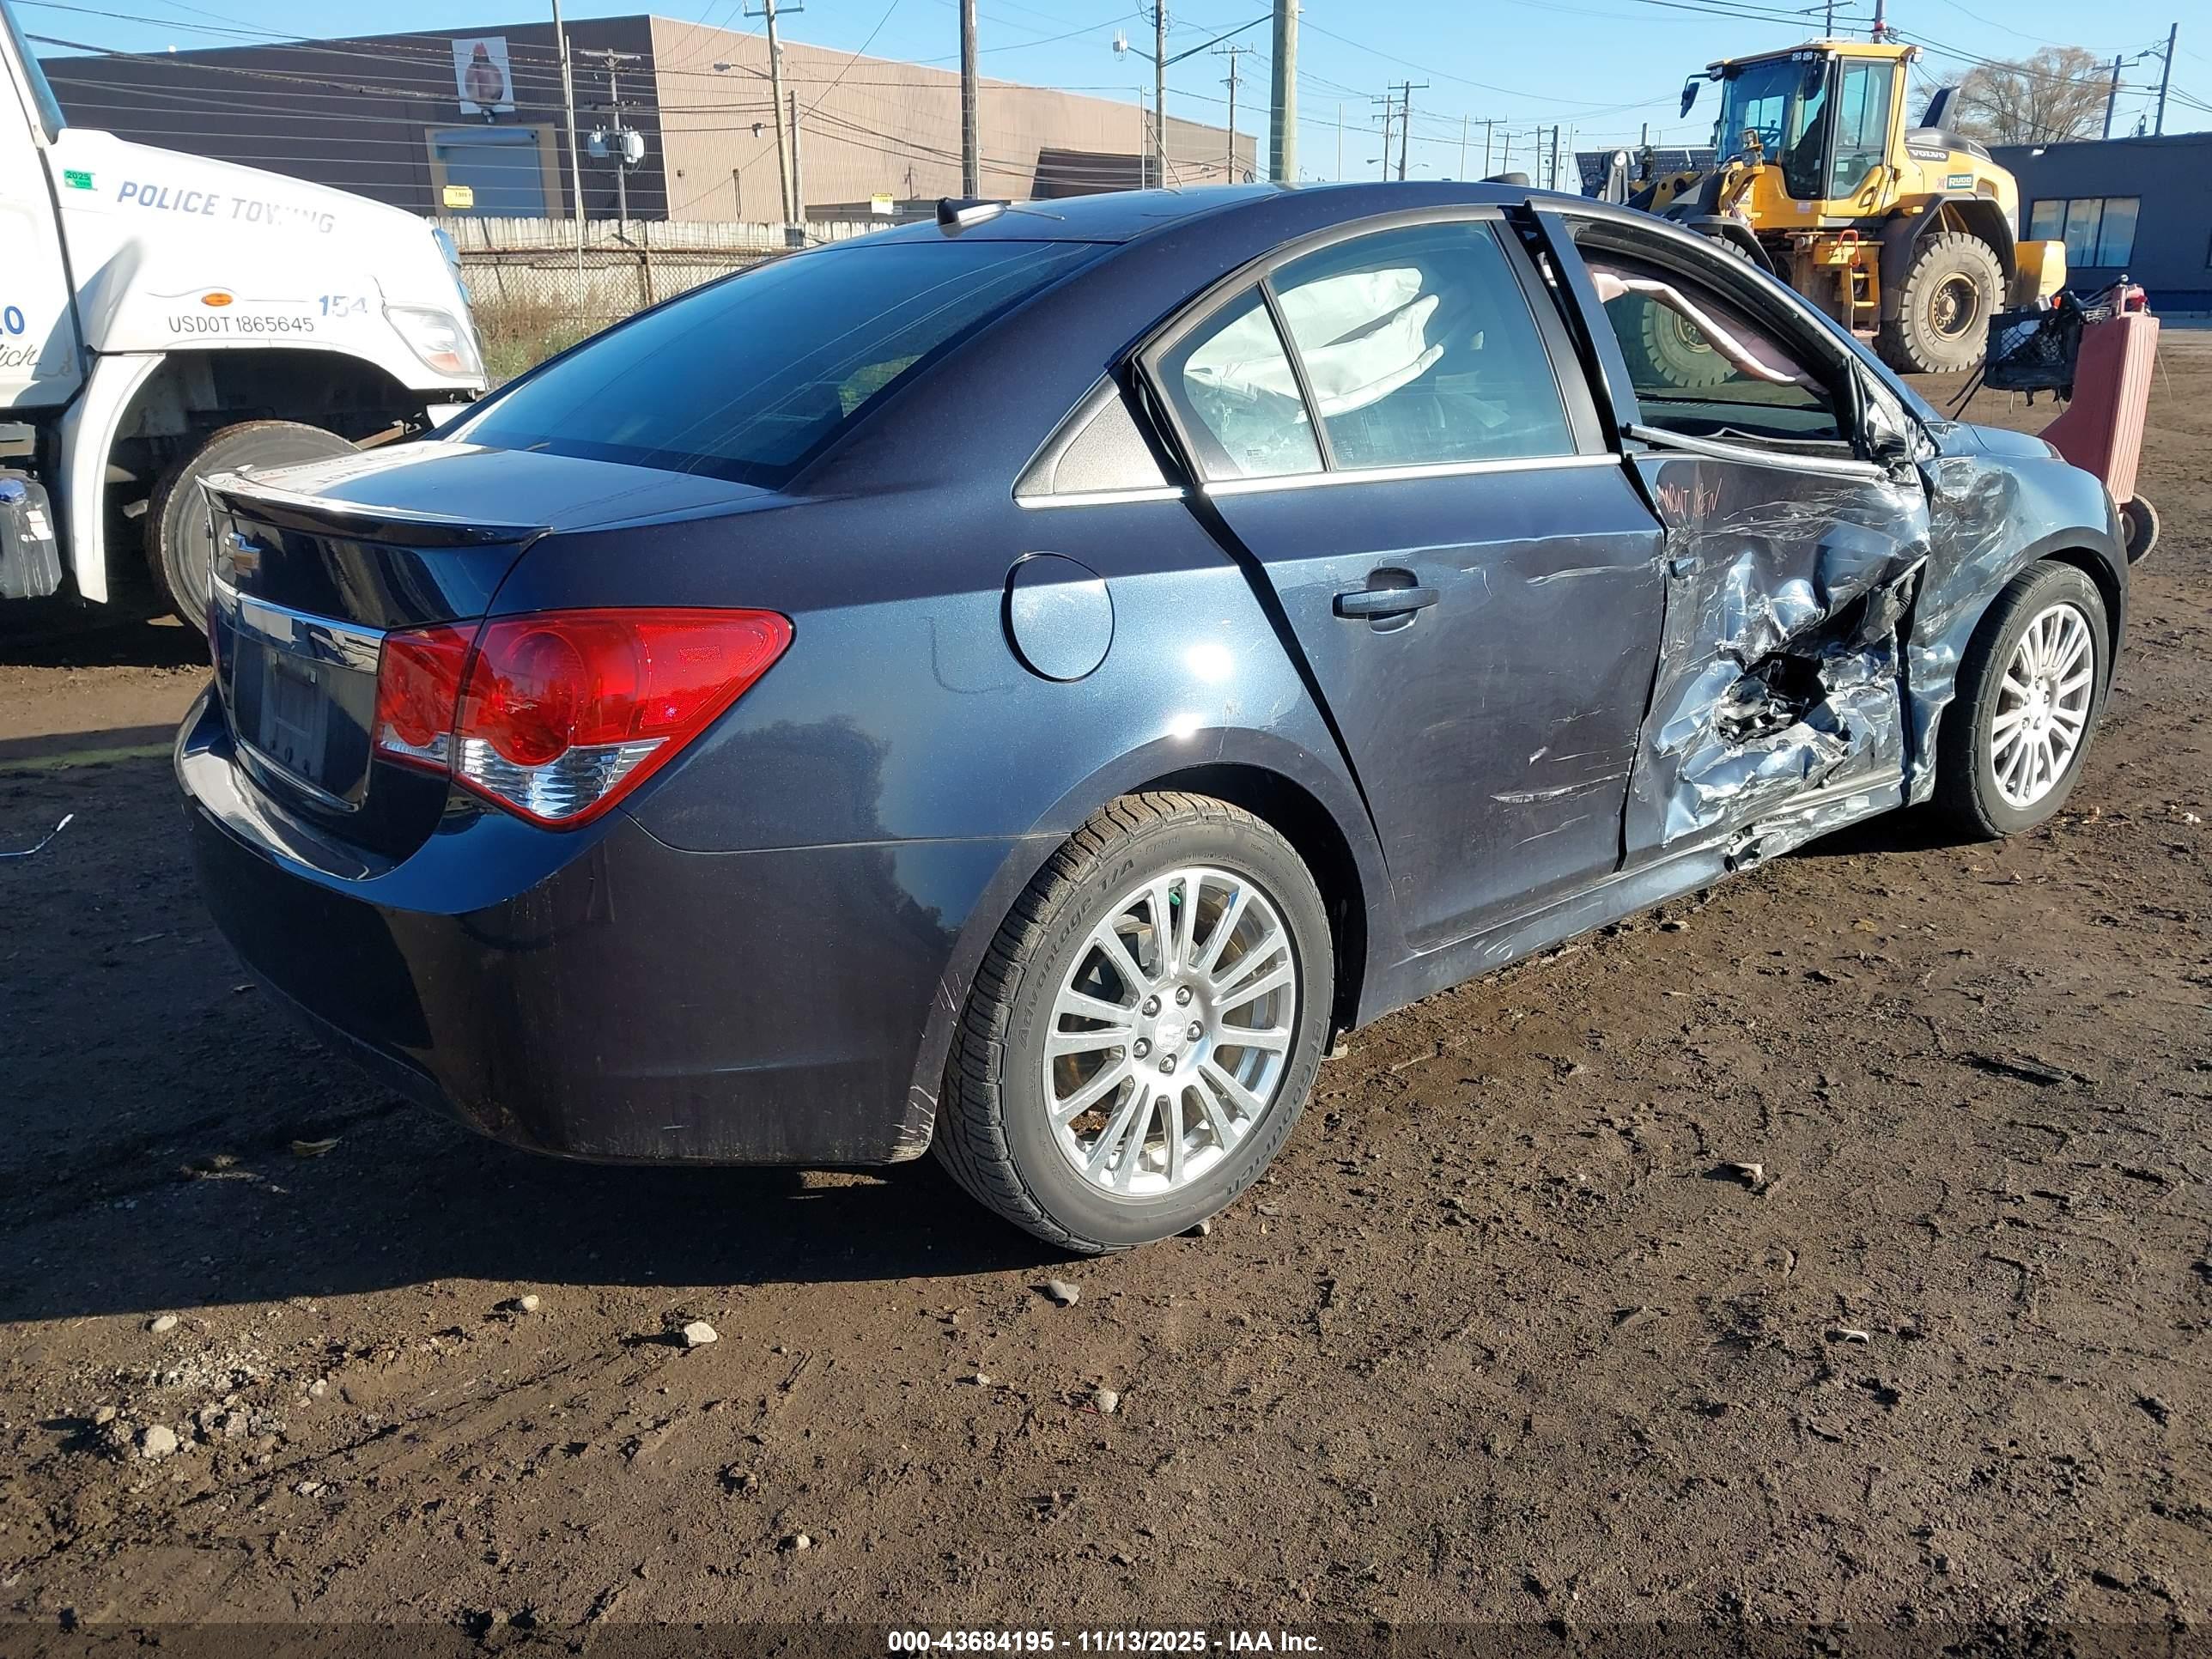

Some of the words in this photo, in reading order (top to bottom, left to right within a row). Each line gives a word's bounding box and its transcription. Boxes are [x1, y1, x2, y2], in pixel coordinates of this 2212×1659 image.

[1908, 149, 1947, 159] VOLVO
[67, 171, 90, 180] 2025
[117, 180, 221, 216] POLICE
[231, 197, 336, 234] TOWNG
[168, 315, 230, 332] USDOT
[236, 316, 314, 332] 1865645
[1097, 859, 1135, 895] T/A
